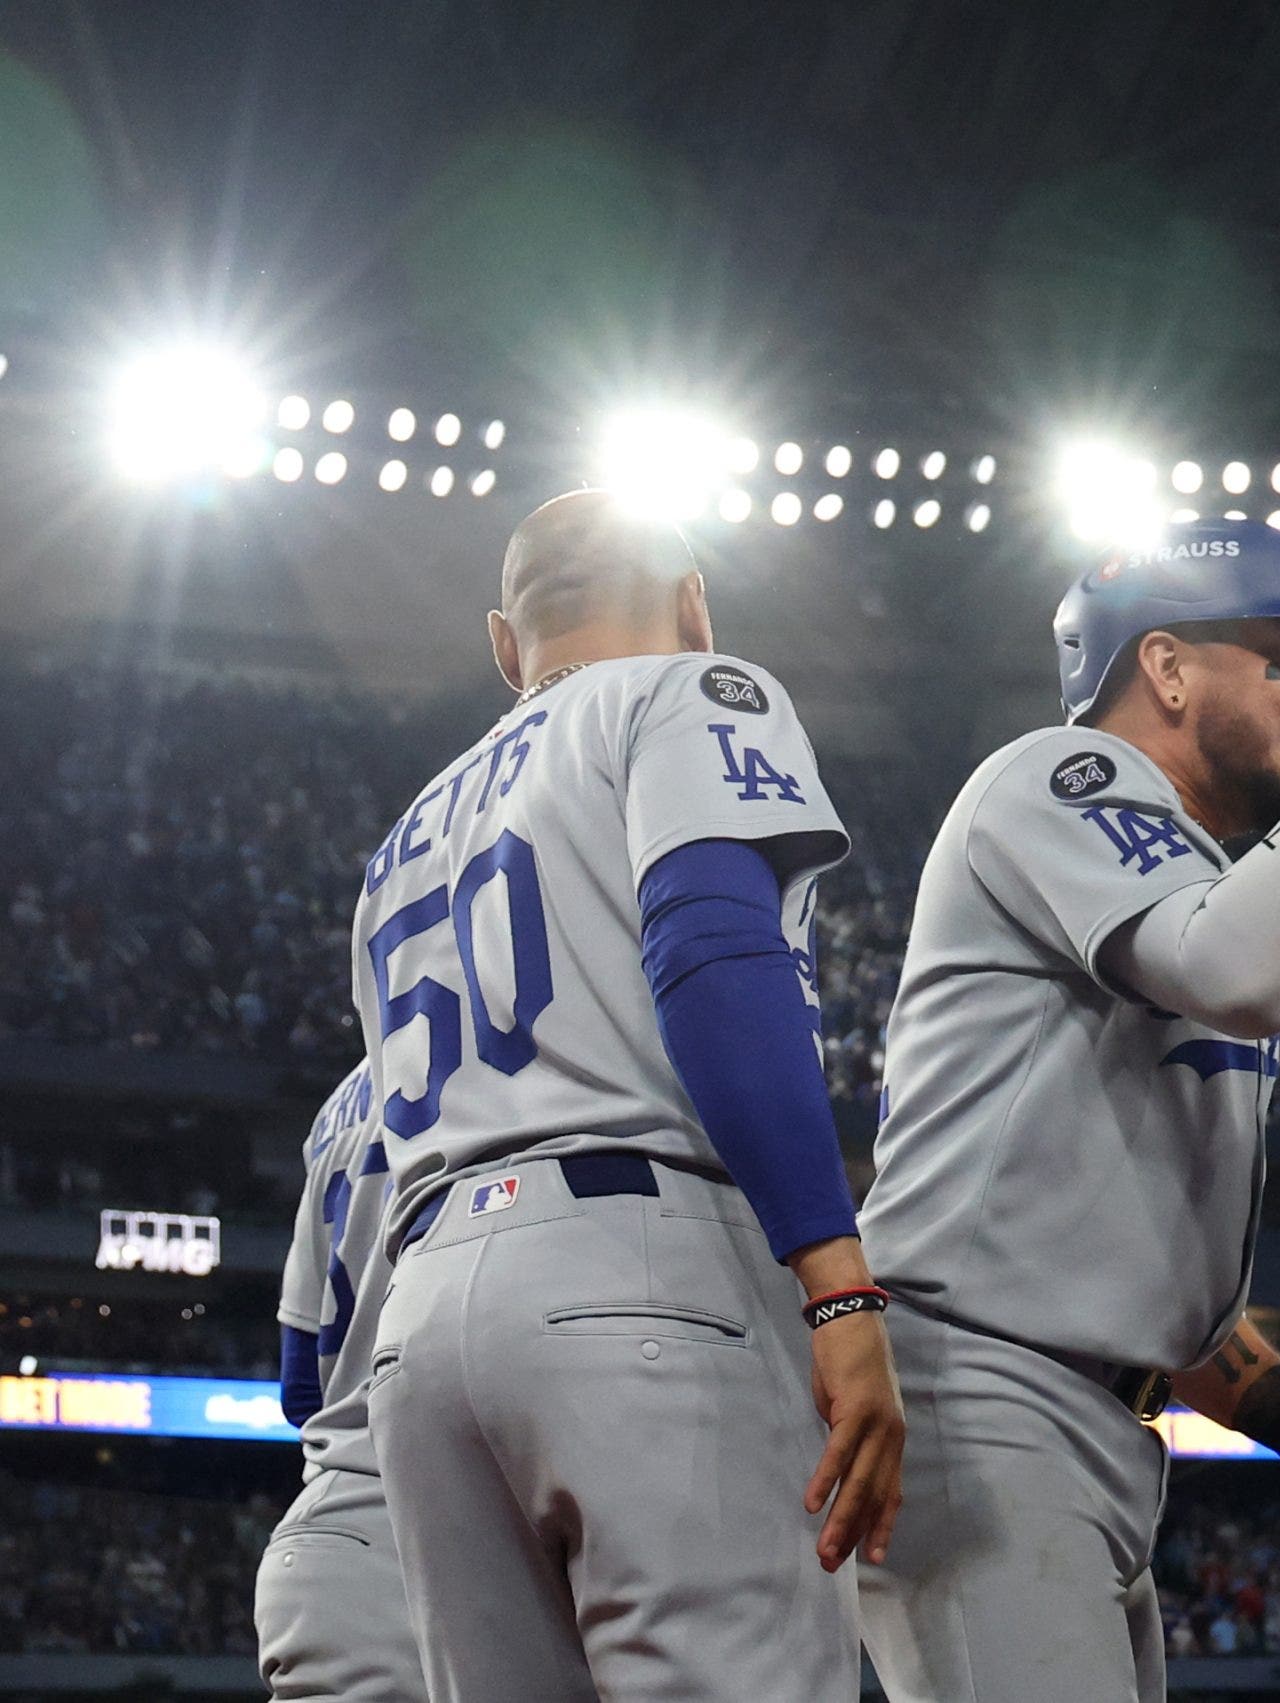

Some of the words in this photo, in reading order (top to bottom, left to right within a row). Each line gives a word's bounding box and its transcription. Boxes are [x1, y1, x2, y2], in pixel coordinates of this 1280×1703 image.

[1127, 540, 1241, 569] STRAUSS
[711, 672, 755, 688] FERNANDO
[716, 681, 760, 709] 34
[707, 723, 807, 805] LA
[1056, 756, 1097, 780] FERNANDO
[1064, 763, 1107, 793] 34
[366, 710, 548, 897] BETTS
[1080, 804, 1192, 876] LA
[367, 827, 554, 1141] 50
